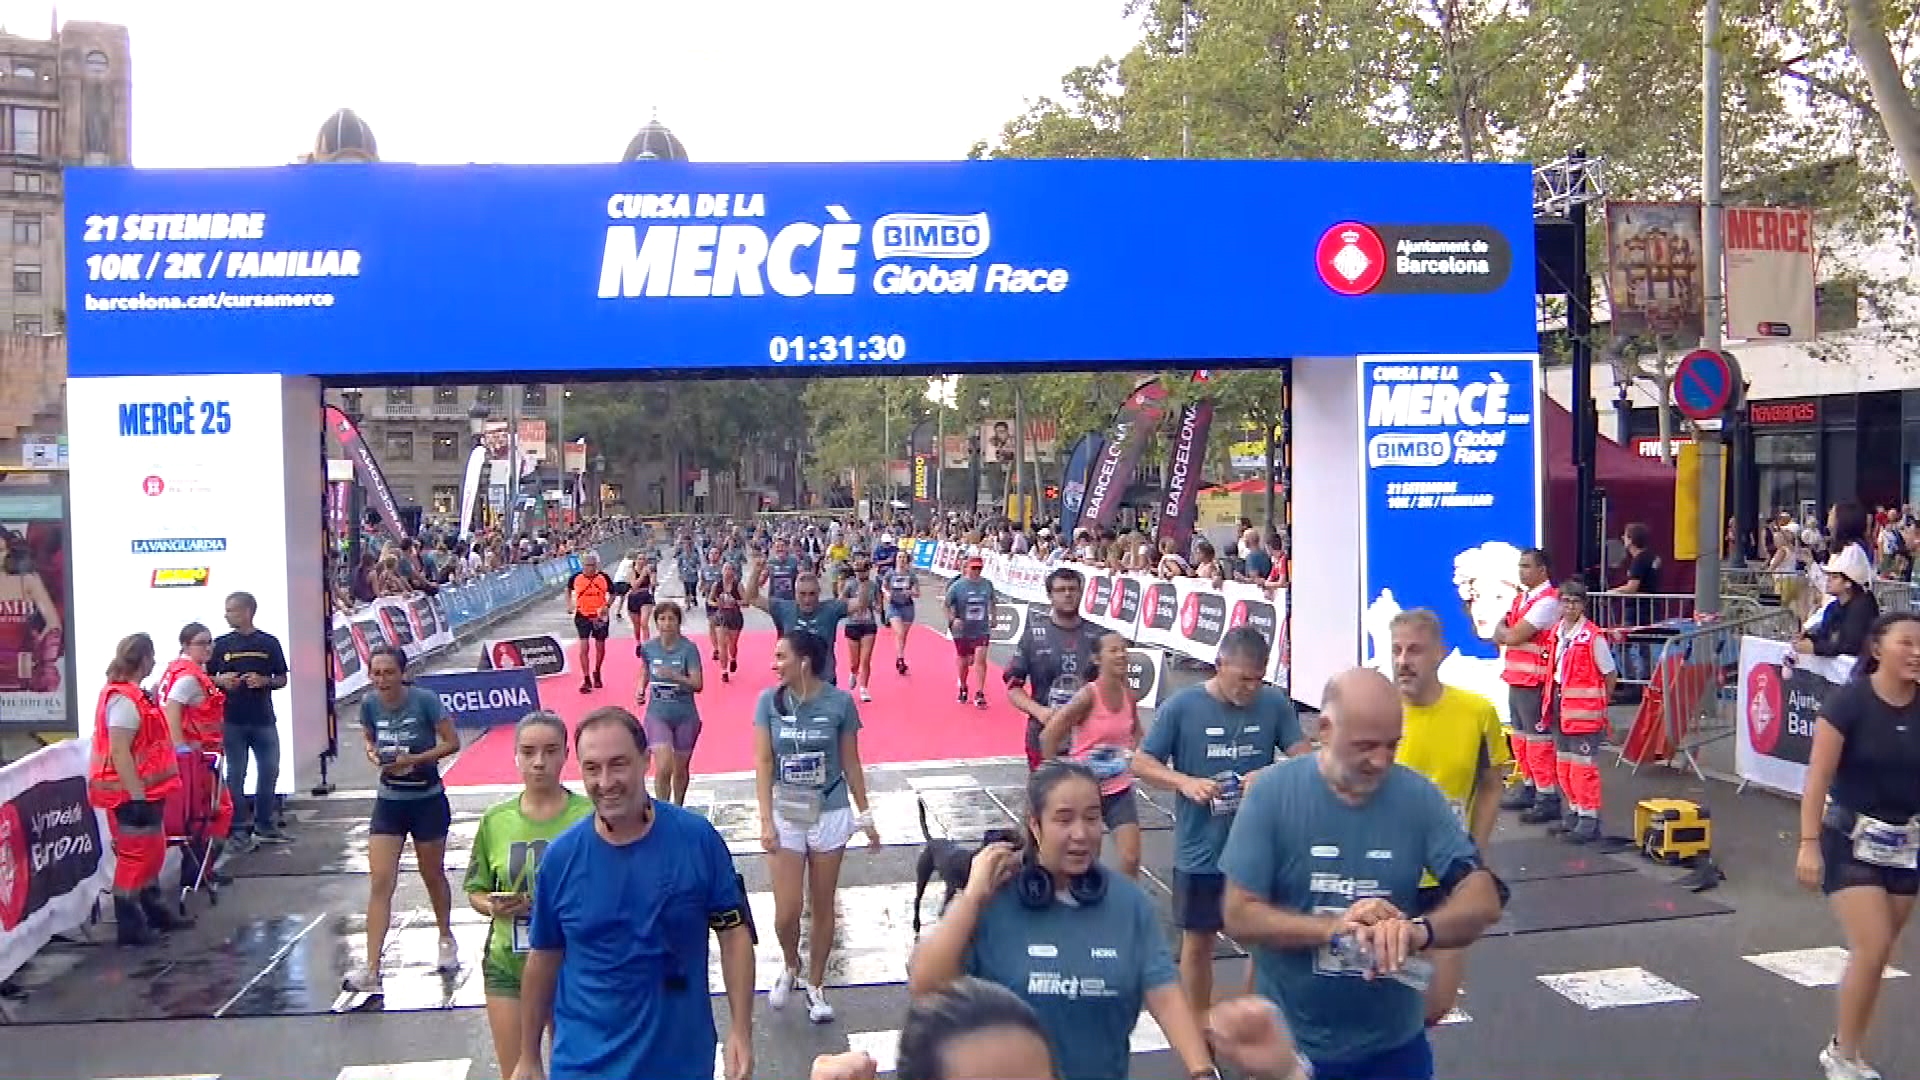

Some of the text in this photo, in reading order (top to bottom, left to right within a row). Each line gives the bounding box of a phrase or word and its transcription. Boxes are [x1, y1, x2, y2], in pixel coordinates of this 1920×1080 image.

[607, 194, 765, 218] CURSA DE LA
[84, 212, 265, 241] 21 SETEMBRE
[884, 224, 981, 248] BIMBO
[598, 205, 861, 298] MERCÈ
[1397, 239, 1489, 257] Ajuntament de
[86, 250, 361, 280] 10K / 2K / FAMILIAR
[1396, 256, 1490, 274] Barcelona
[873, 263, 1069, 295] Global Race
[85, 291, 335, 311] barcelona.cat/cursamerce
[769, 333, 906, 362] 01:31:30
[1368, 372, 1510, 426] MERCÈ
[1752, 403, 1815, 422] havaianas
[118, 396, 231, 436] MERCÈ 25
[1377, 441, 1444, 459] BIMBO
[440, 686, 532, 713] RCELONA
